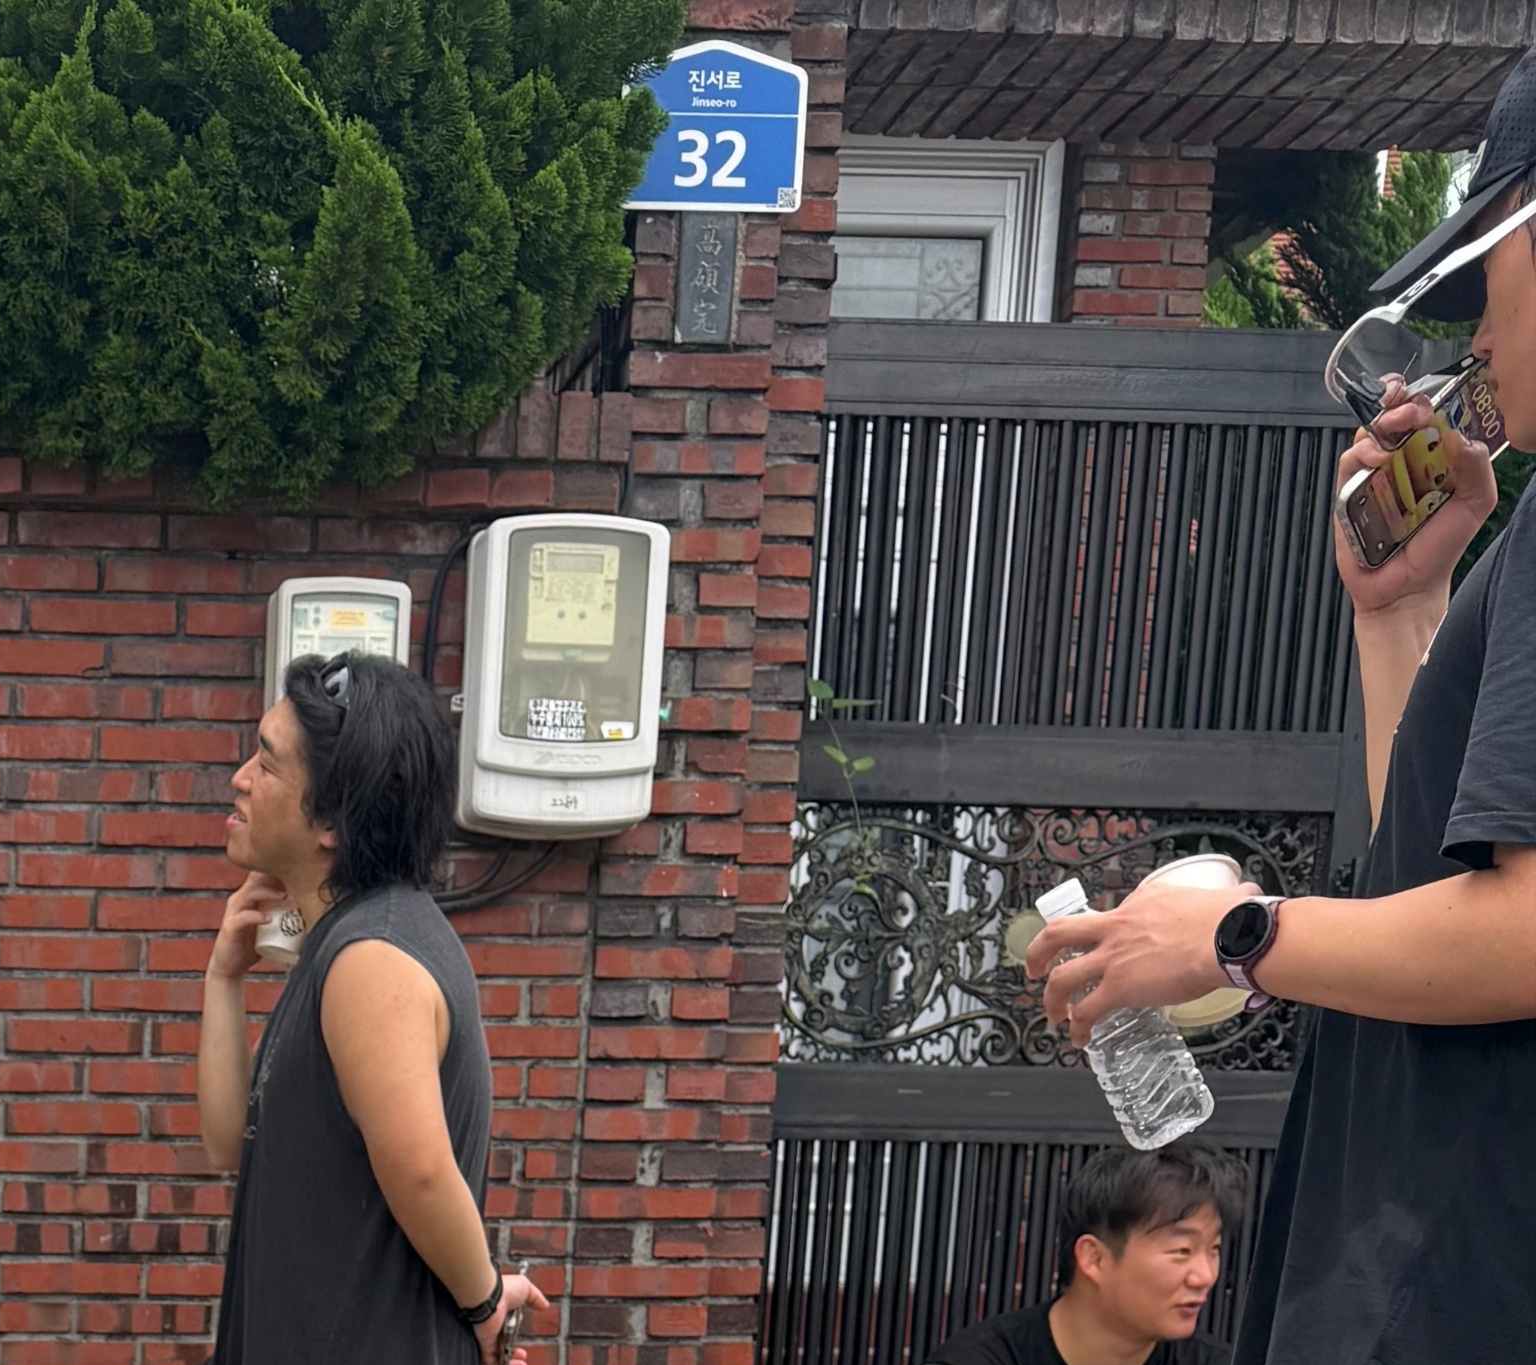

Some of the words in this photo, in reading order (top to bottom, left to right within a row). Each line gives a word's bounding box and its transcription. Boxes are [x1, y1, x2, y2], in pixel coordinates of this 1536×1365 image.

[688, 69, 743, 92] 진서로
[691, 96, 737, 108] Jinseo-ro
[673, 129, 747, 188] 32
[1472, 383, 1501, 438] 08:00
